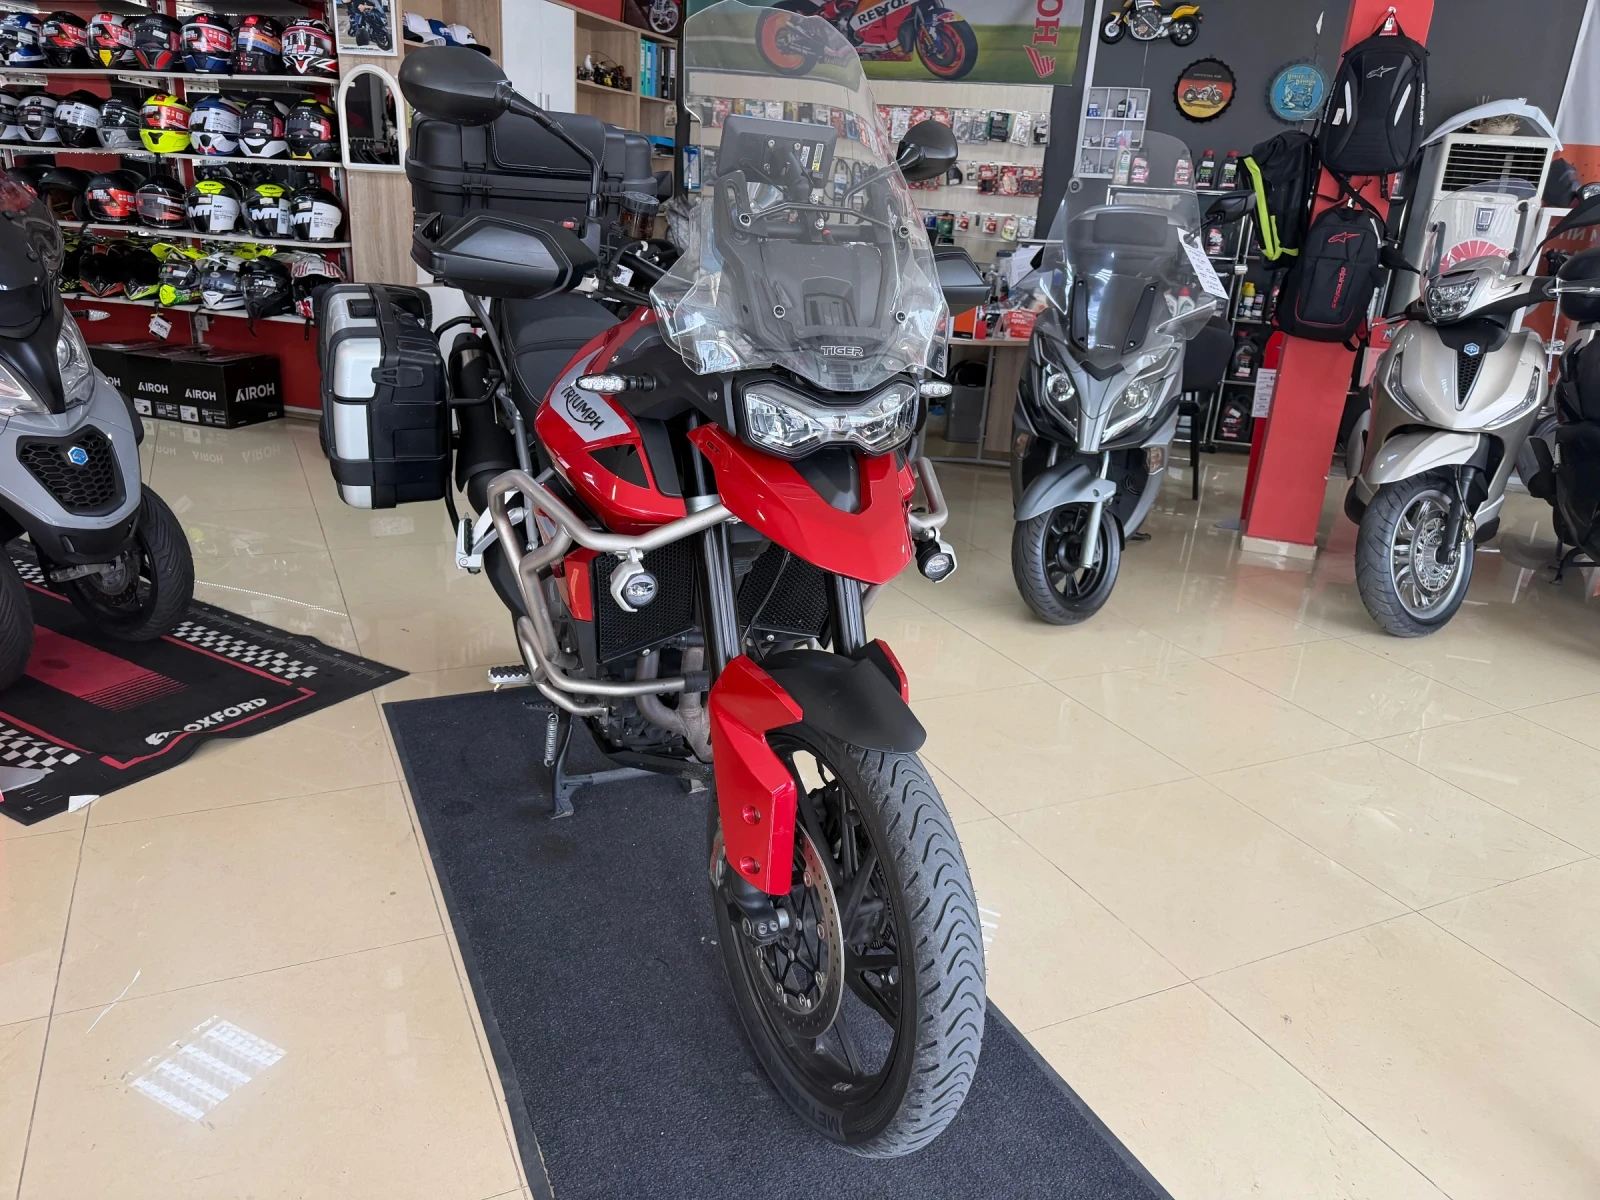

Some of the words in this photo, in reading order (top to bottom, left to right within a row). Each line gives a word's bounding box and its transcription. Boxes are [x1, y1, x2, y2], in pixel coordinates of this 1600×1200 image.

[820, 345, 864, 357] TIGER
[137, 381, 169, 395] AIROH
[184, 388, 217, 402] AIROH
[235, 382, 276, 403] AIROH
[560, 385, 605, 431] TRIUMPH
[182, 697, 268, 733] OXFORD
